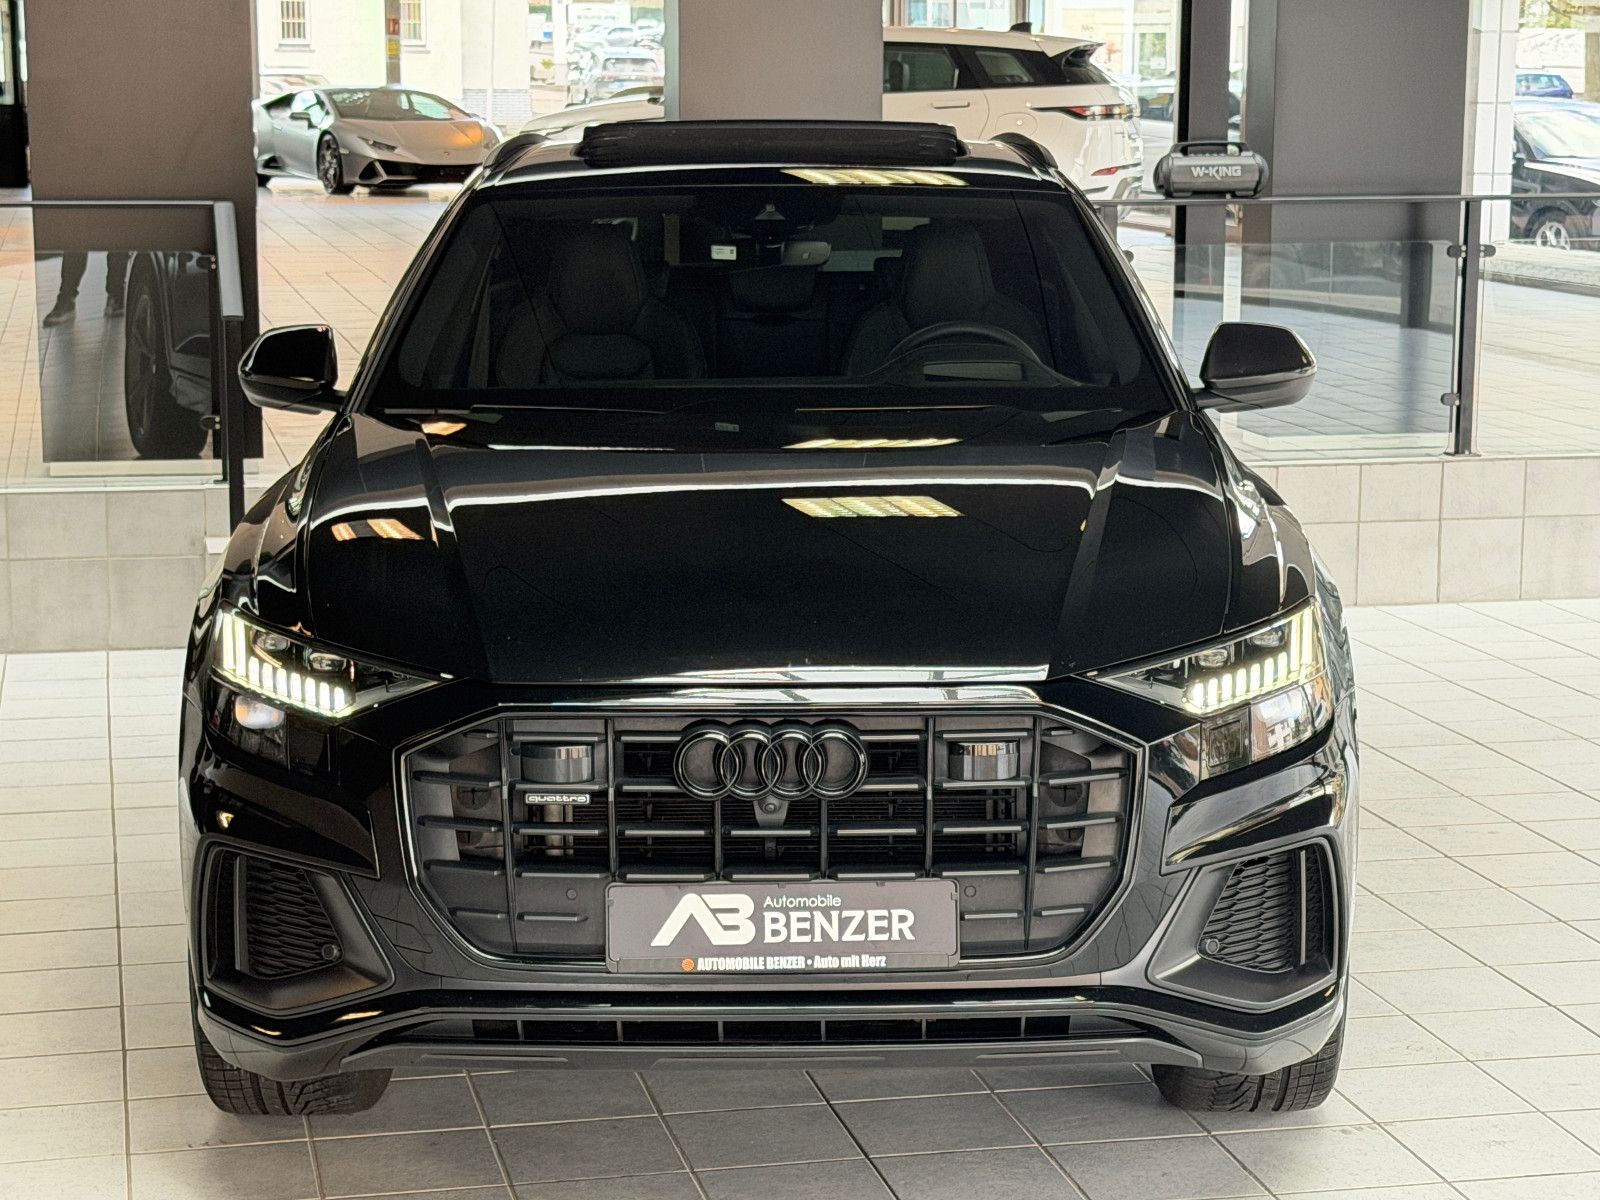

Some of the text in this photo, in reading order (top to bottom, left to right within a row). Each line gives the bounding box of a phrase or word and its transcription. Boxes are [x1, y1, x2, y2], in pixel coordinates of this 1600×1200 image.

[1191, 166, 1242, 180] W-KING
[528, 795, 587, 803] quattro
[763, 894, 842, 908] Automobile
[651, 893, 756, 947] AB
[763, 909, 916, 943] BENZER
[697, 954, 887, 971] AUTOMOBILE BENZER Auto mit Herz
